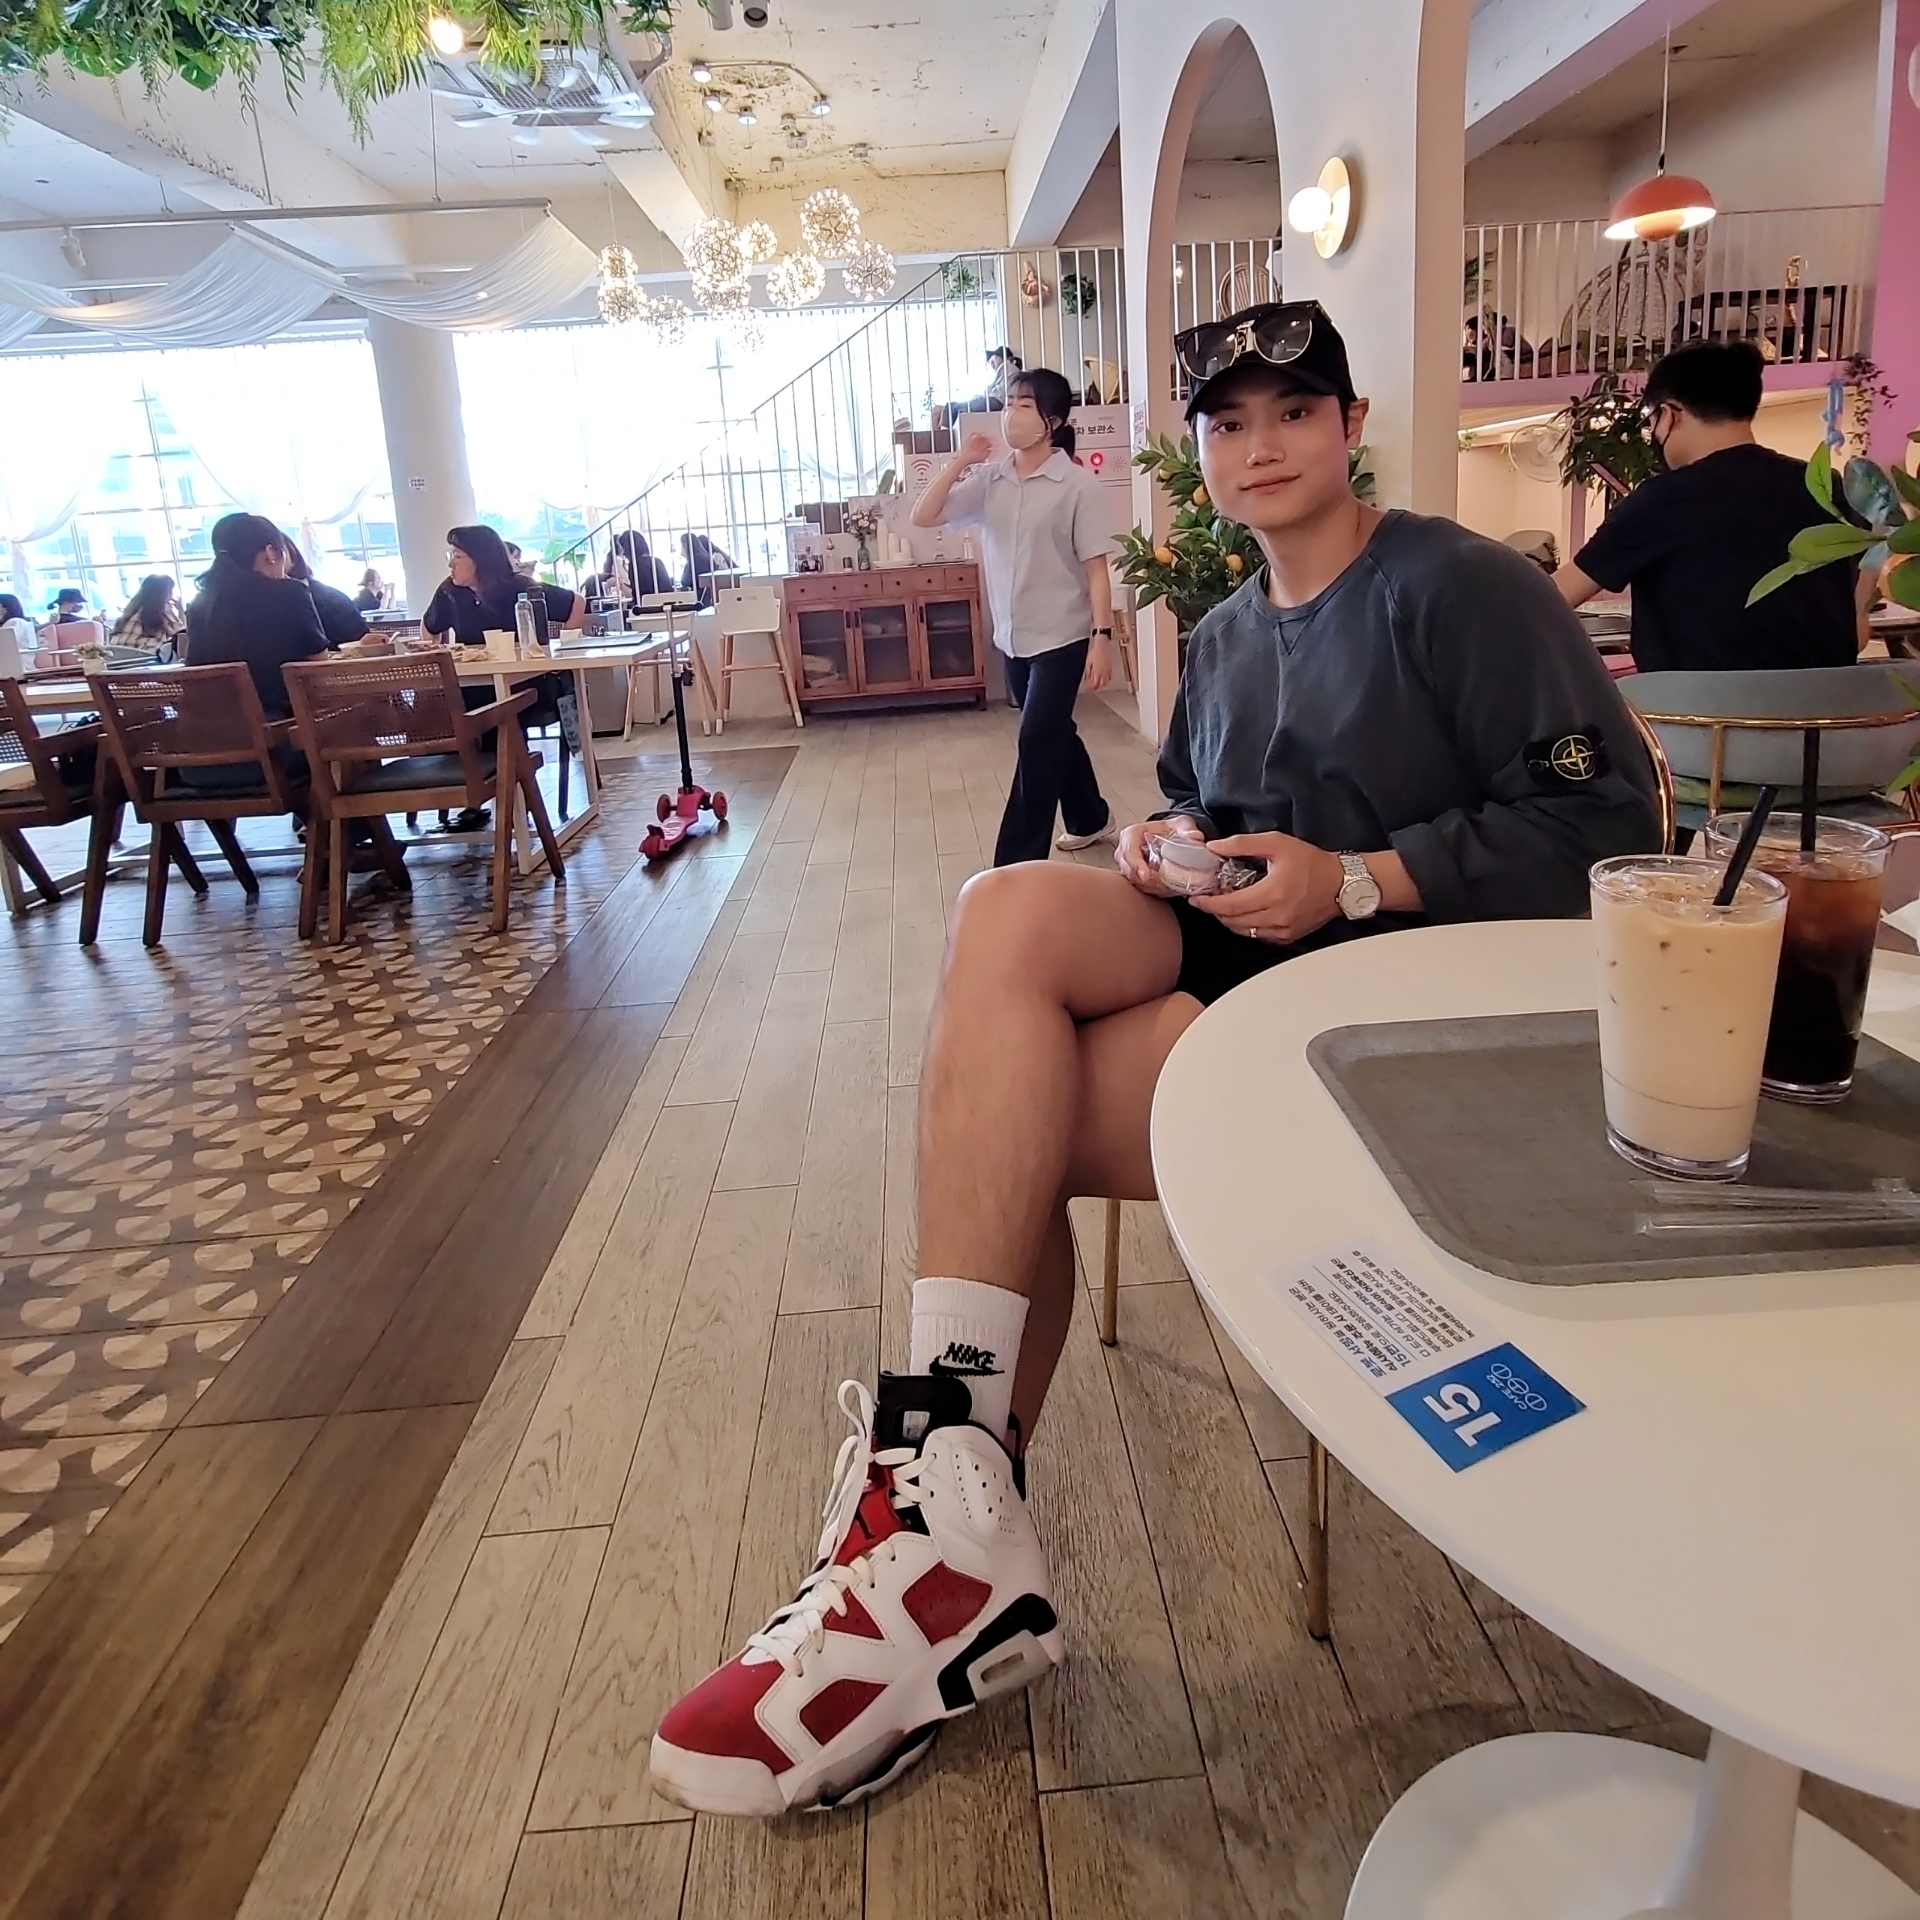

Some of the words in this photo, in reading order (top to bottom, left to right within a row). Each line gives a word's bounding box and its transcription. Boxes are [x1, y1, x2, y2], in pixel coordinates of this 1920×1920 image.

[1087, 424, 1116, 435] 보관소
[1330, 1258, 1346, 1269] 분은
[1296, 1279, 1315, 1293] 넘버
[1331, 1272, 1355, 1290] 곳으로
[1343, 1269, 1373, 1292] 어려우신
[1360, 1270, 1383, 1288] 주시면
[1288, 1286, 1307, 1301] 분은
[1311, 1293, 1338, 1315] 테이블
[1353, 1289, 1383, 1314] 반납하는
[1370, 1291, 1395, 1311] 퇴식이
[1305, 1301, 1336, 1329] 원하시는
[1333, 1314, 1347, 1322] 시
[1381, 1314, 1404, 1333] 식기는
[1403, 1306, 1429, 1327] 넘버를
[1343, 1322, 1363, 1339] 주문
[1426, 1326, 1454, 1348] 테이블
[1333, 1329, 1364, 1354] 서빙을
[1370, 1330, 1411, 1367] 15번으로
[1402, 1334, 1422, 1349] 드신
[943, 1341, 996, 1369] NIKE
[1362, 1339, 1397, 1371] 식사메뉴
[1418, 1348, 1431, 1357] 다
[1359, 1356, 1386, 1377] 로봇
[1500, 1387, 1527, 1409] CAFE
[1422, 1383, 1501, 1447] 15
